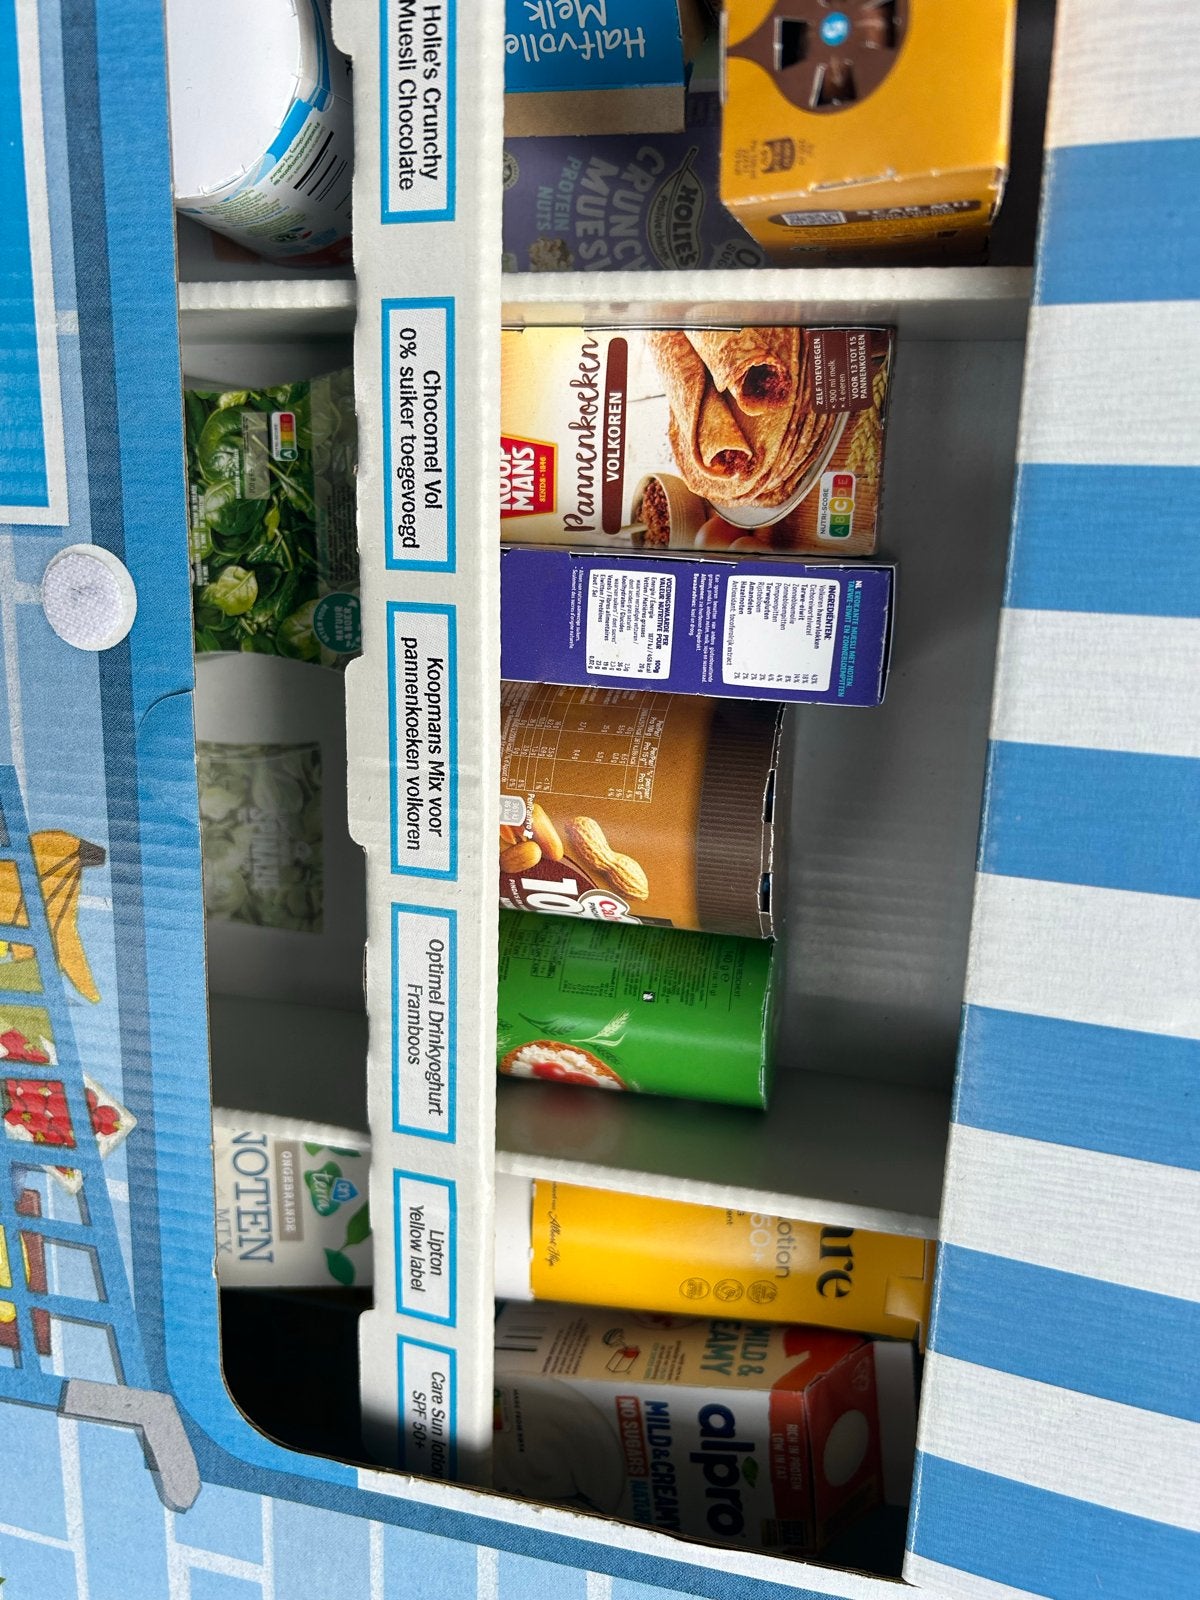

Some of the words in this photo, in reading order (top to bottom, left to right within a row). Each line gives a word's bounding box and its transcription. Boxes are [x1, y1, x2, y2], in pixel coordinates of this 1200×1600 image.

[397, 0, 417, 71] Muesli
[421, 5, 442, 80] Holie's
[398, 79, 417, 191] Chocolate
[418, 87, 442, 181] Crunchy
[536, 186, 555, 231] NUTS
[554, 156, 583, 231] PROTEIN
[673, 185, 701, 267] HOLIE'S
[399, 328, 418, 360] 0%
[814, 338, 822, 386] TOEVOEGEN
[849, 337, 857, 345] 15
[850, 347, 858, 363] TOT
[850, 364, 858, 374] 13
[850, 376, 859, 399] VOOR
[858, 334, 867, 399] PANNENKOEKEN
[399, 366, 419, 428] suiker
[423, 370, 442, 473] Chocomel
[562, 336, 601, 532] Pannenkoeken
[606, 392, 623, 482] VOLKOREN
[396, 434, 420, 548] toegevoegd
[424, 480, 443, 510] Vol
[511, 447, 535, 511] MANS
[820, 488, 829, 535] NUTRI-SCORE
[663, 578, 672, 633] VOEDINGSWAARDE
[739, 581, 747, 615] Hazelnoten
[747, 581, 756, 615] Amandelen
[764, 582, 773, 620] Tarwegluten
[780, 583, 790, 630] Zonnebloempitten
[789, 584, 799, 624] Zonnebloemolie
[818, 585, 826, 608] Volkoren
[851, 591, 861, 624] KROKANTE
[855, 581, 862, 589] NL
[656, 601, 664, 632] NUTRITIVE
[814, 609, 823, 649] havervlokken
[824, 585, 836, 640] INGREDIËNTEN:
[843, 625, 851, 634] EN
[848, 651, 856, 664] MET
[850, 627, 858, 649] MUESLI
[838, 635, 850, 697] ZONNEBLOEMPITTEN
[400, 637, 422, 770] pannenkoeken
[422, 657, 443, 754] Koopmans
[428, 761, 444, 791] Mix
[405, 776, 423, 850] volkoren
[427, 797, 442, 837] voor
[423, 939, 445, 1005] Optimel
[406, 983, 423, 1064] Framboos
[421, 1011, 445, 1115] Drinkyoghurt
[281, 1151, 296, 1232] ONGEBRANDE
[312, 1170, 331, 1211] terra
[409, 1205, 425, 1251] Yellow
[410, 1255, 426, 1291] label
[427, 1230, 445, 1275] Lipton
[742, 1326, 771, 1360] MILD
[431, 1371, 445, 1404] Care
[737, 1365, 765, 1376] &
[413, 1390, 427, 1418] SPF
[431, 1408, 445, 1436] Sun
[620, 1399, 638, 1418] NO
[413, 1422, 427, 1448] 50+
[623, 1422, 646, 1475] SUGARS
[787, 1424, 800, 1441] RICH
[690, 1404, 755, 1536] alpro
